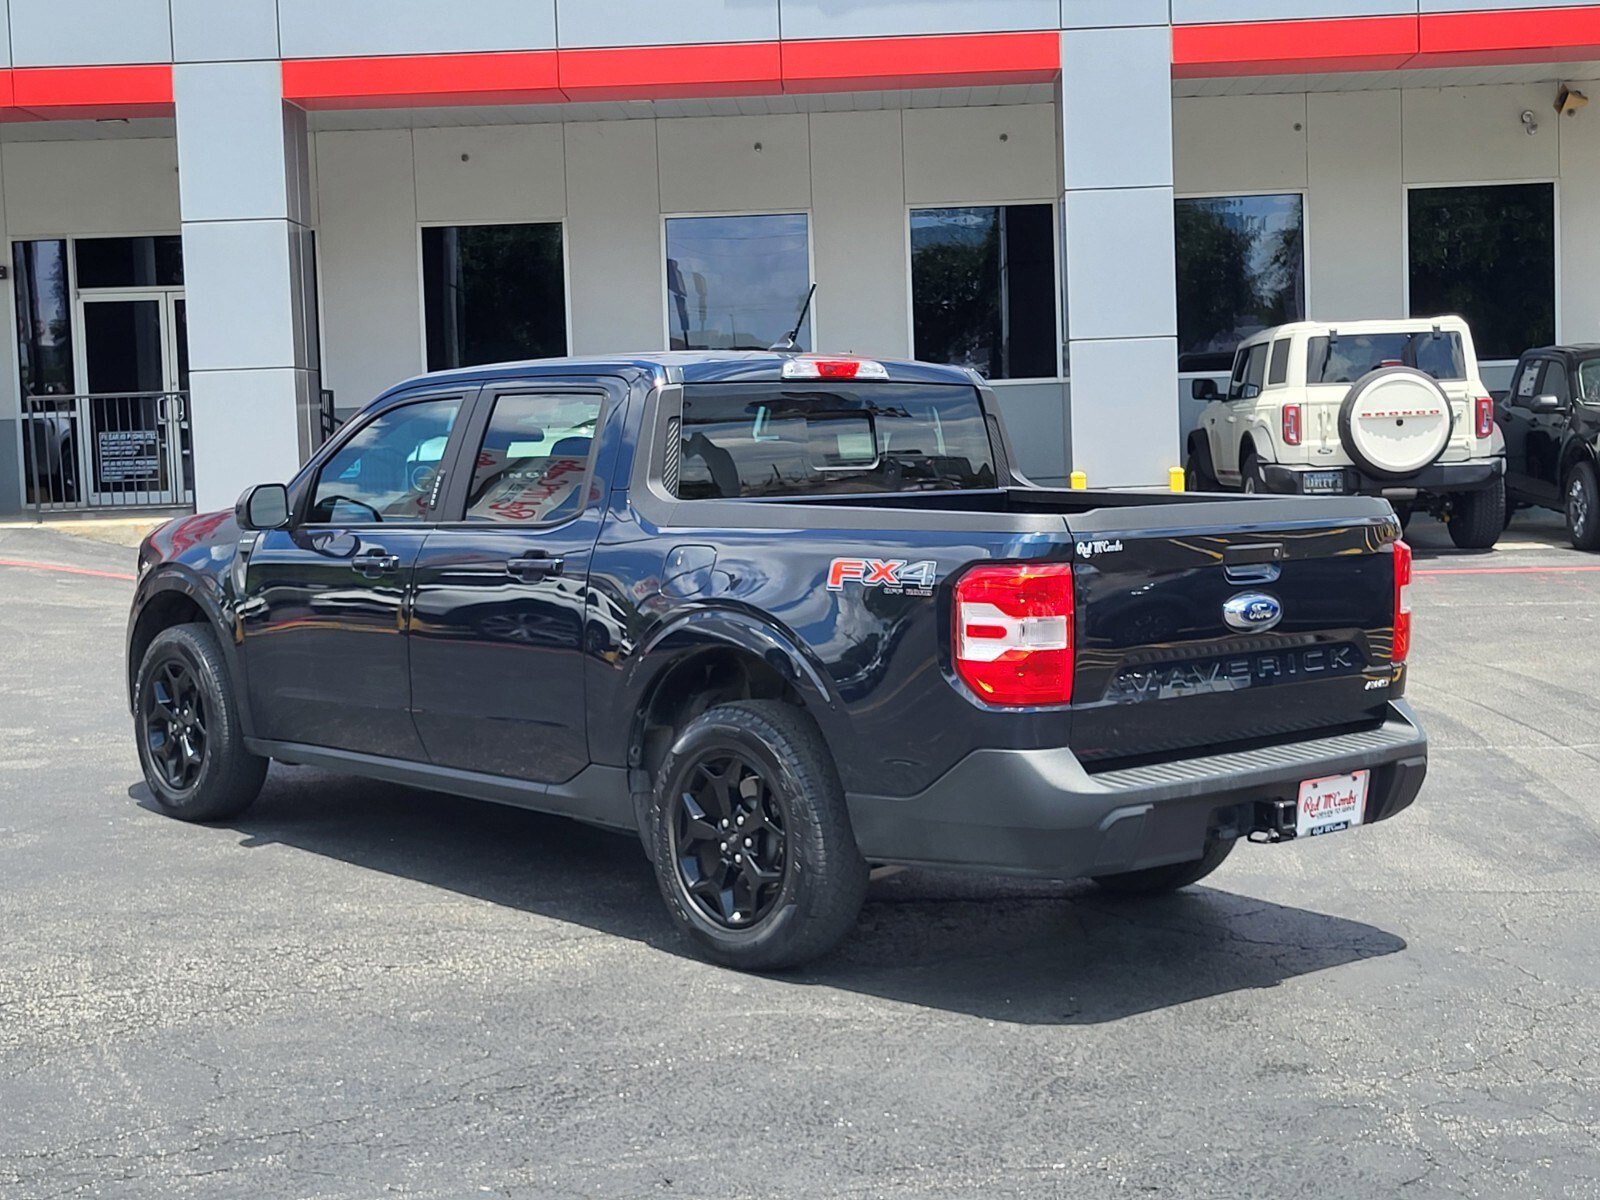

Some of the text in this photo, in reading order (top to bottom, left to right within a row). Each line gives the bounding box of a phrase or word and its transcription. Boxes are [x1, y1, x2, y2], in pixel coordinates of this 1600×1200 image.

[1361, 409, 1440, 418] BRONCO
[826, 557, 937, 591] FX4
[1119, 647, 1353, 694] MAVERICK
[1303, 796, 1321, 818] Red
